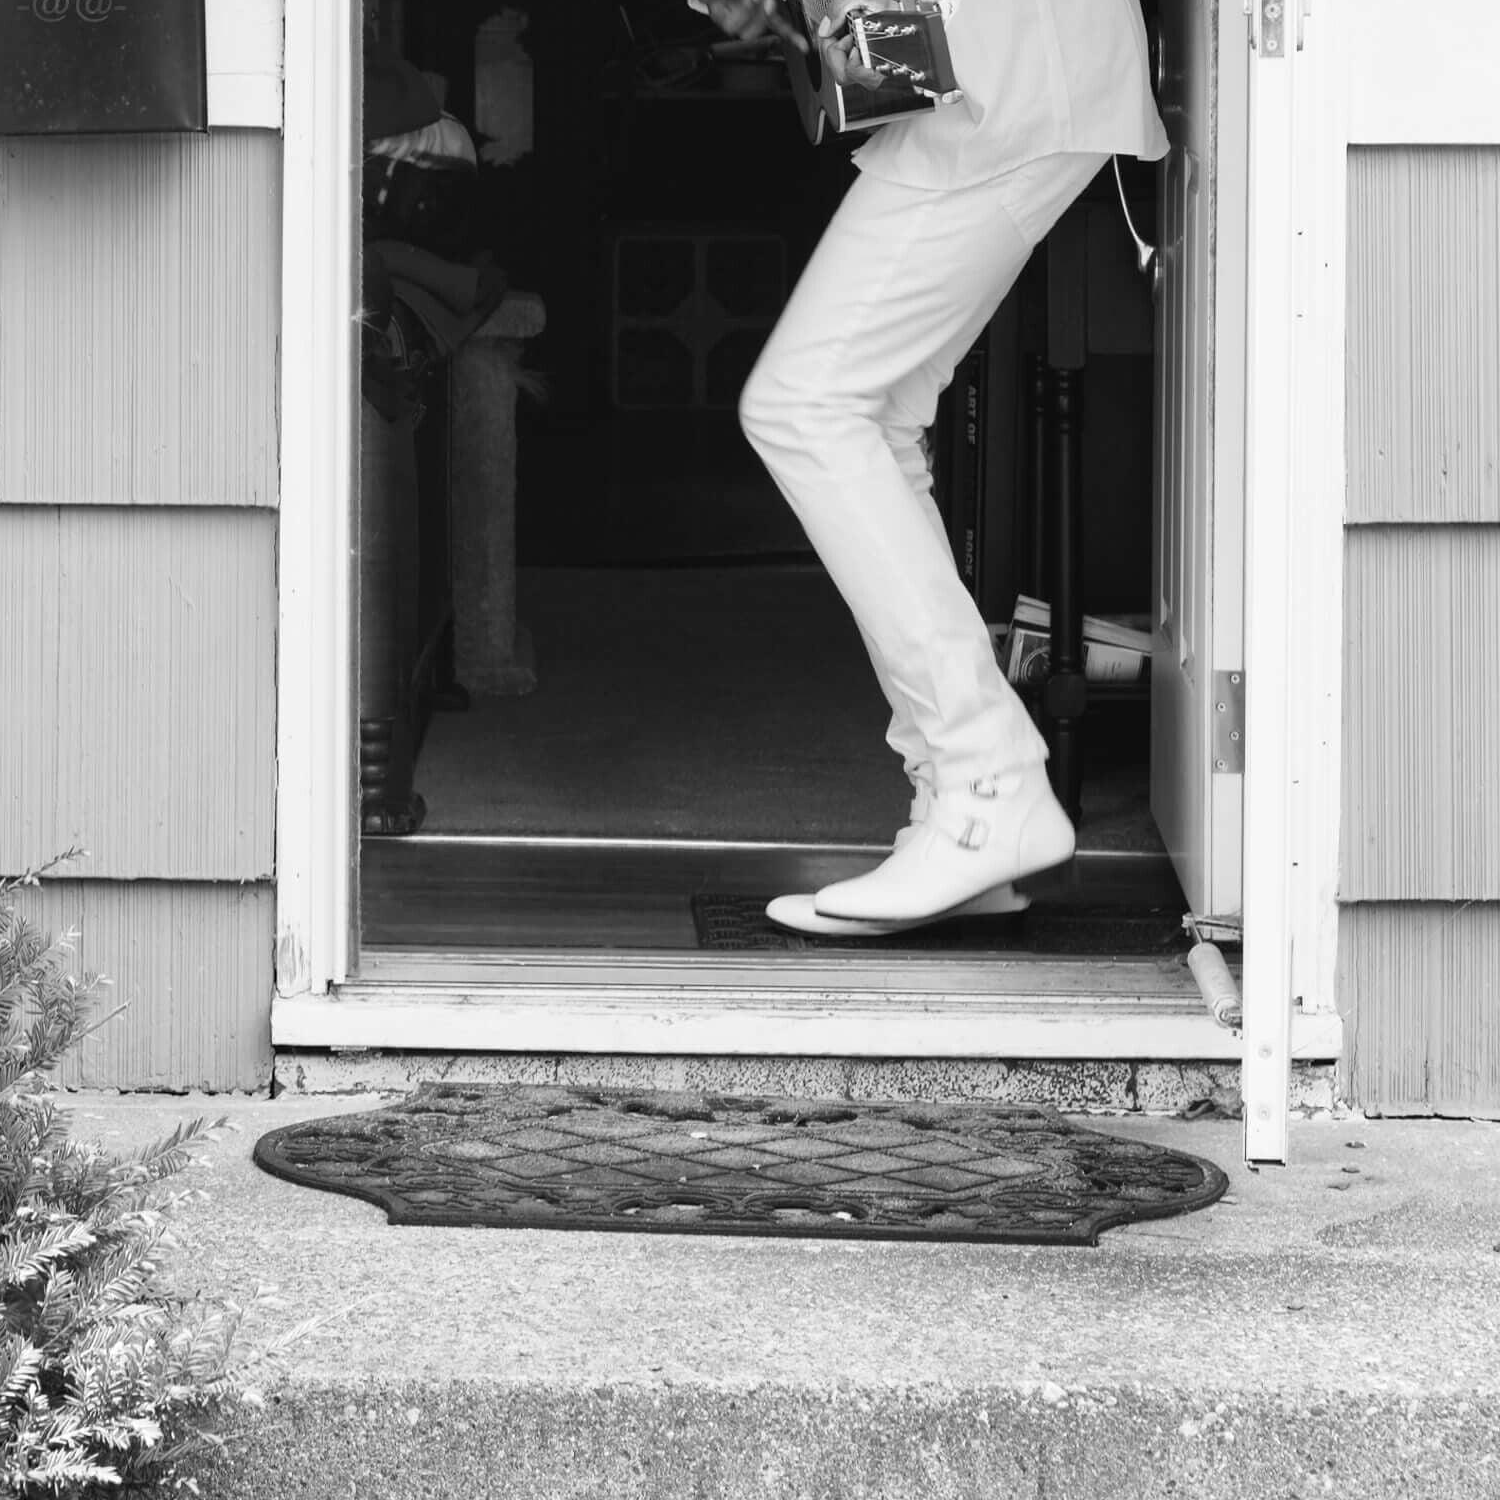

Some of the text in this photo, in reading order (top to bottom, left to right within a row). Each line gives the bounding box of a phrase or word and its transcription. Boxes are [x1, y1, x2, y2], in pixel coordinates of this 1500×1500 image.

[963, 384, 977, 577] ART OF ROCK
